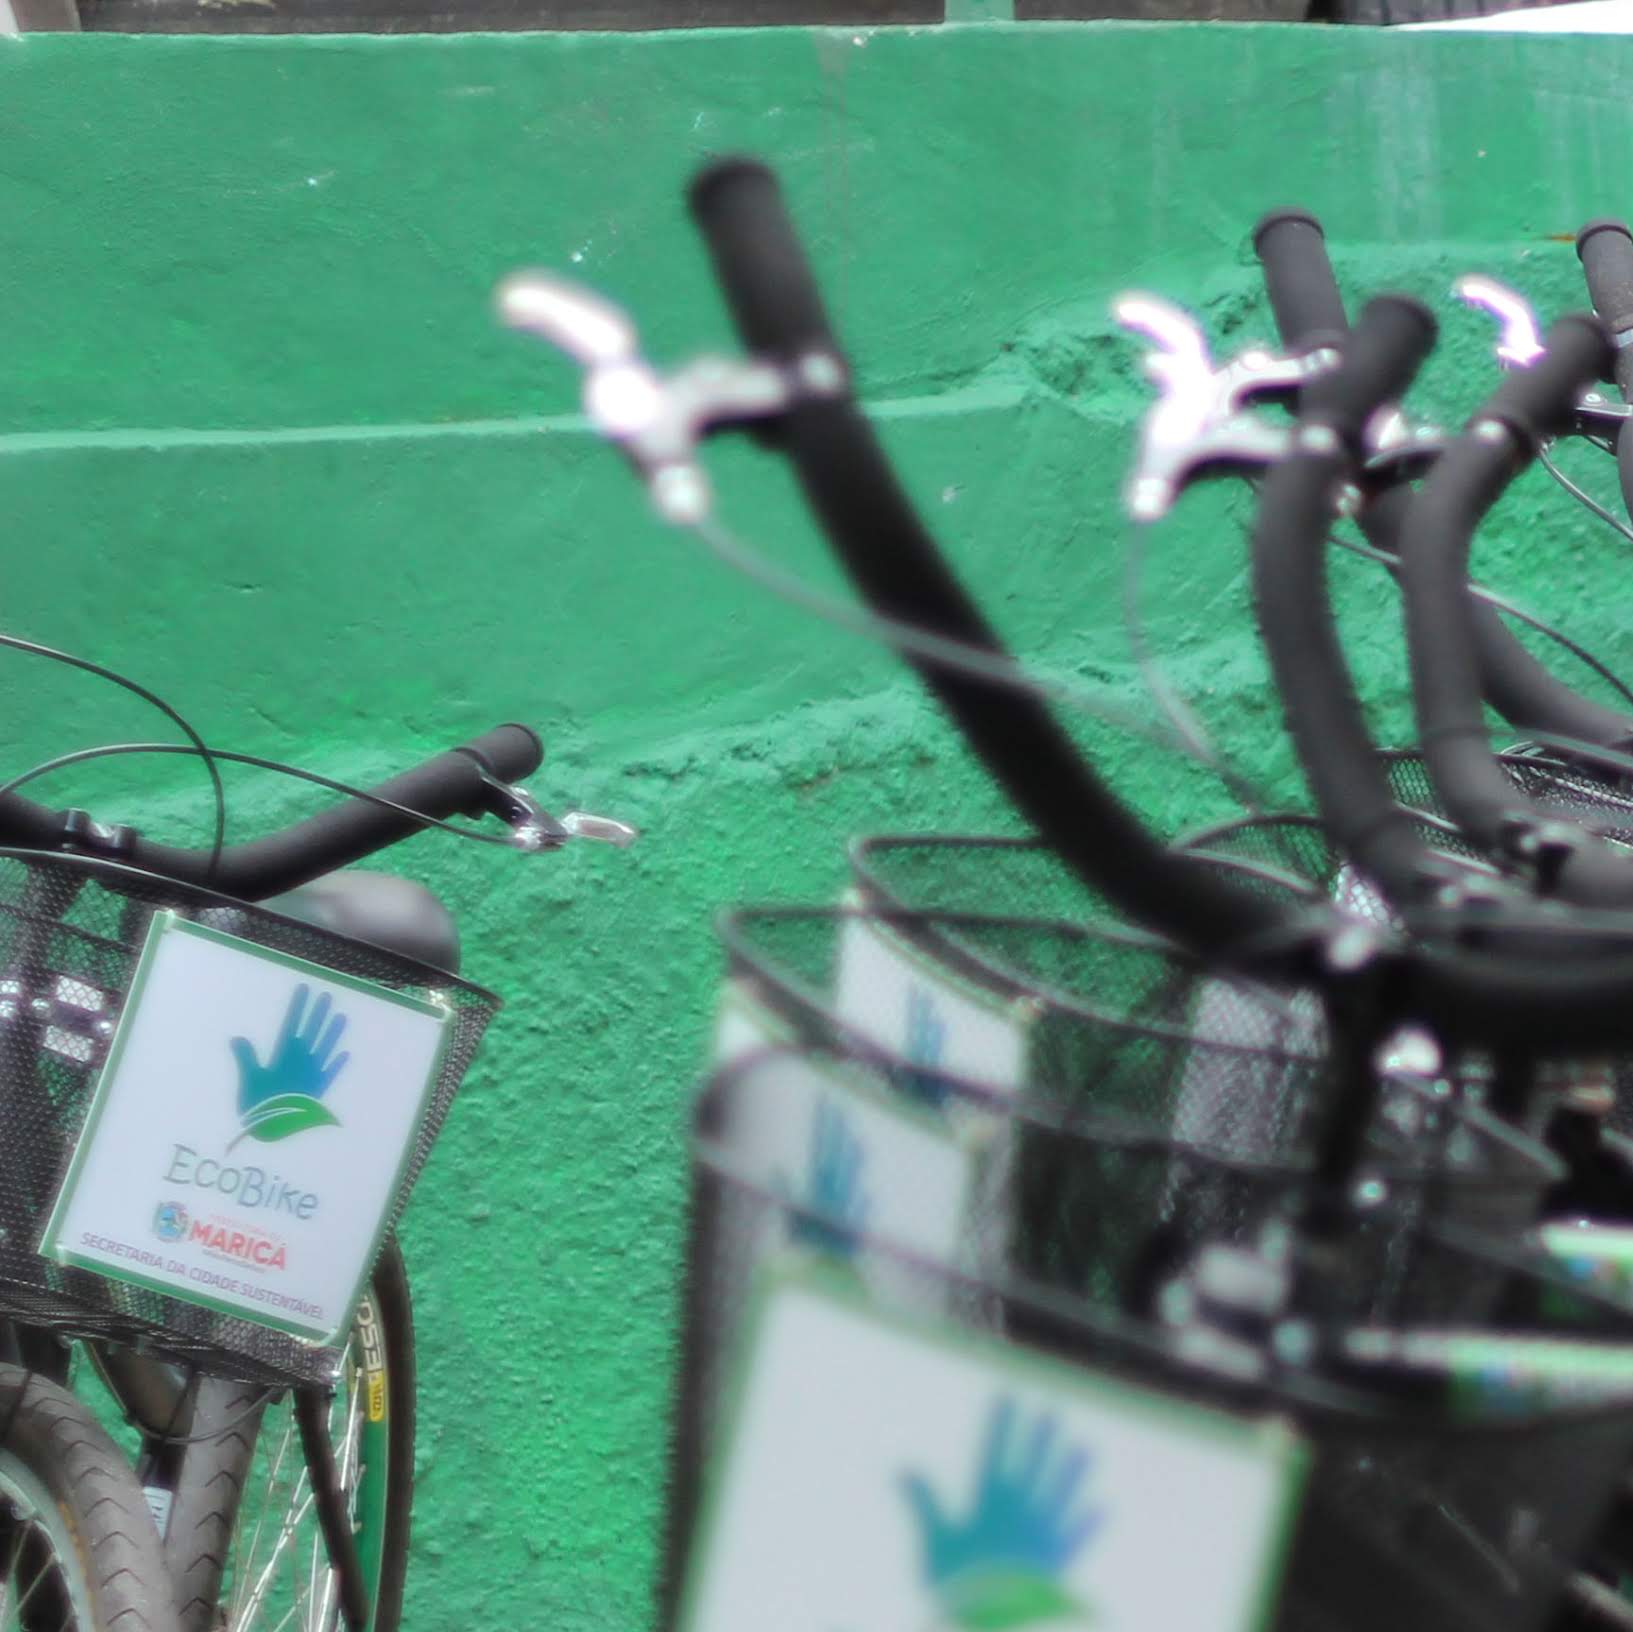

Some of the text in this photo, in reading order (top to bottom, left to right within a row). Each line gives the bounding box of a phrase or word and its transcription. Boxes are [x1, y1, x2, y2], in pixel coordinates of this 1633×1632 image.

[79, 1231, 164, 1269] SECRETARIA
[164, 1259, 187, 1279] DA
[188, 1266, 239, 1293] CIDADE
